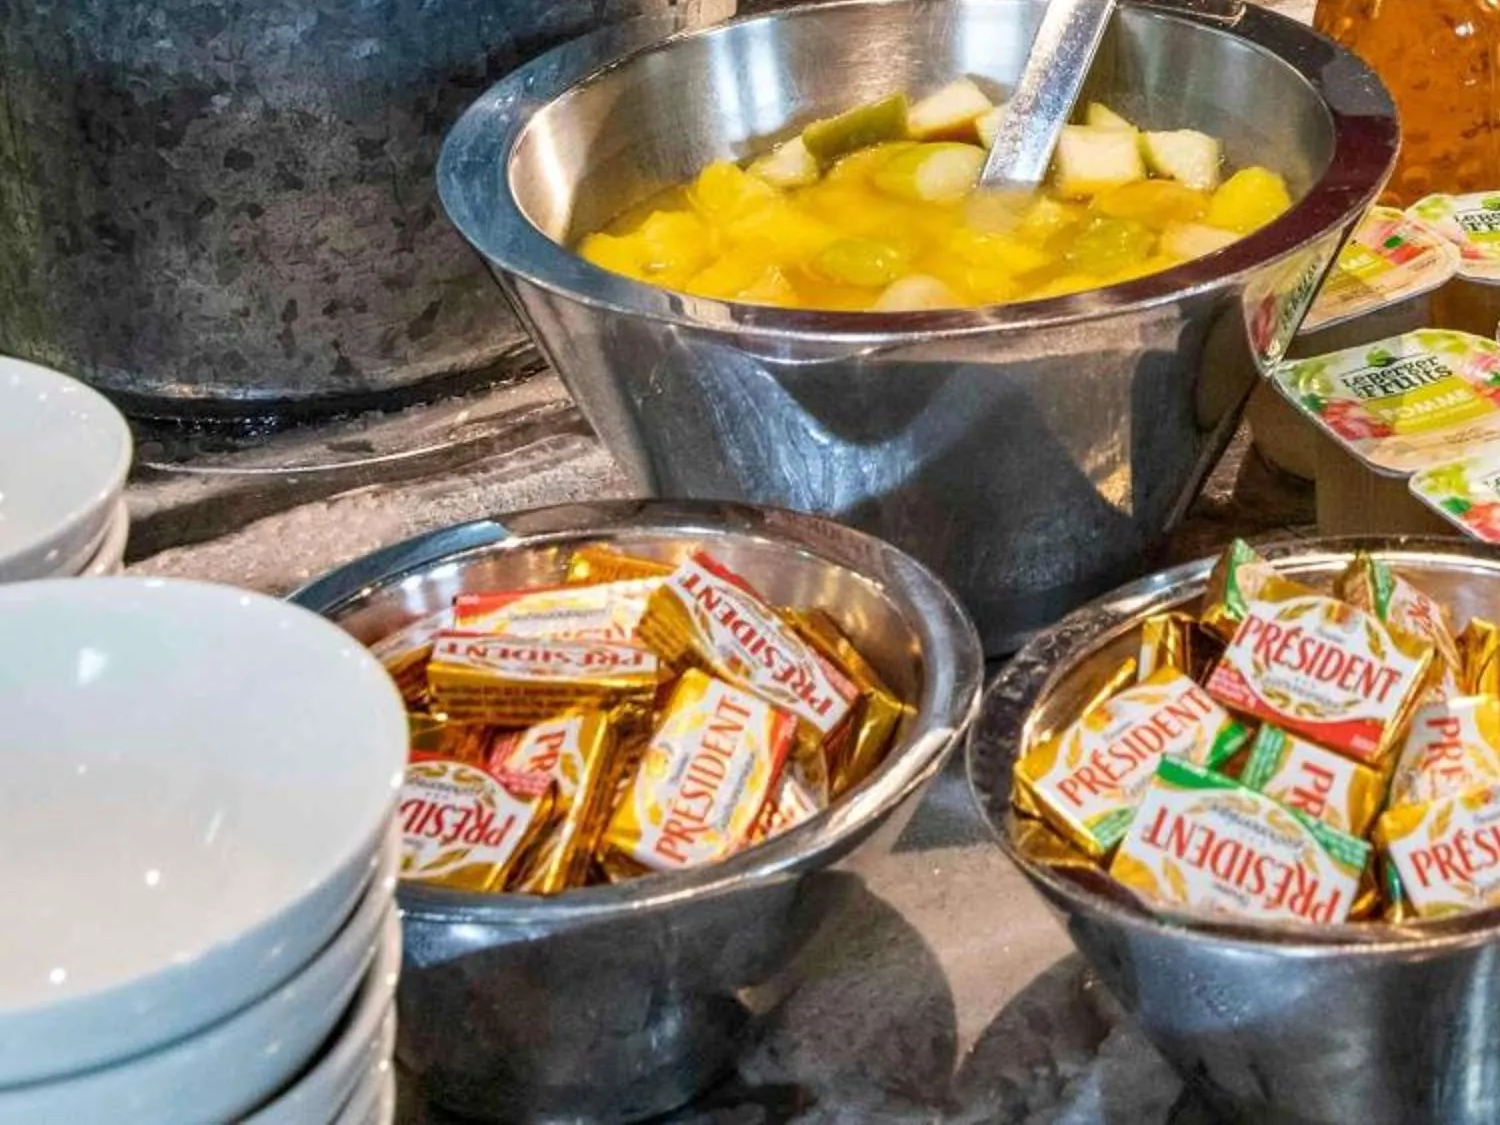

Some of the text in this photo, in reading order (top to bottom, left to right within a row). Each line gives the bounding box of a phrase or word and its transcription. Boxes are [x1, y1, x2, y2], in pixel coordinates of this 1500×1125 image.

[680, 571, 834, 717] PRÉSIDENT
[1234, 614, 1403, 704] PRÉSIDENT
[651, 694, 755, 865] PRÉSIDENT
[1056, 686, 1214, 809] PRÉSIDENT
[1140, 806, 1342, 924] PRÉSIDENT
